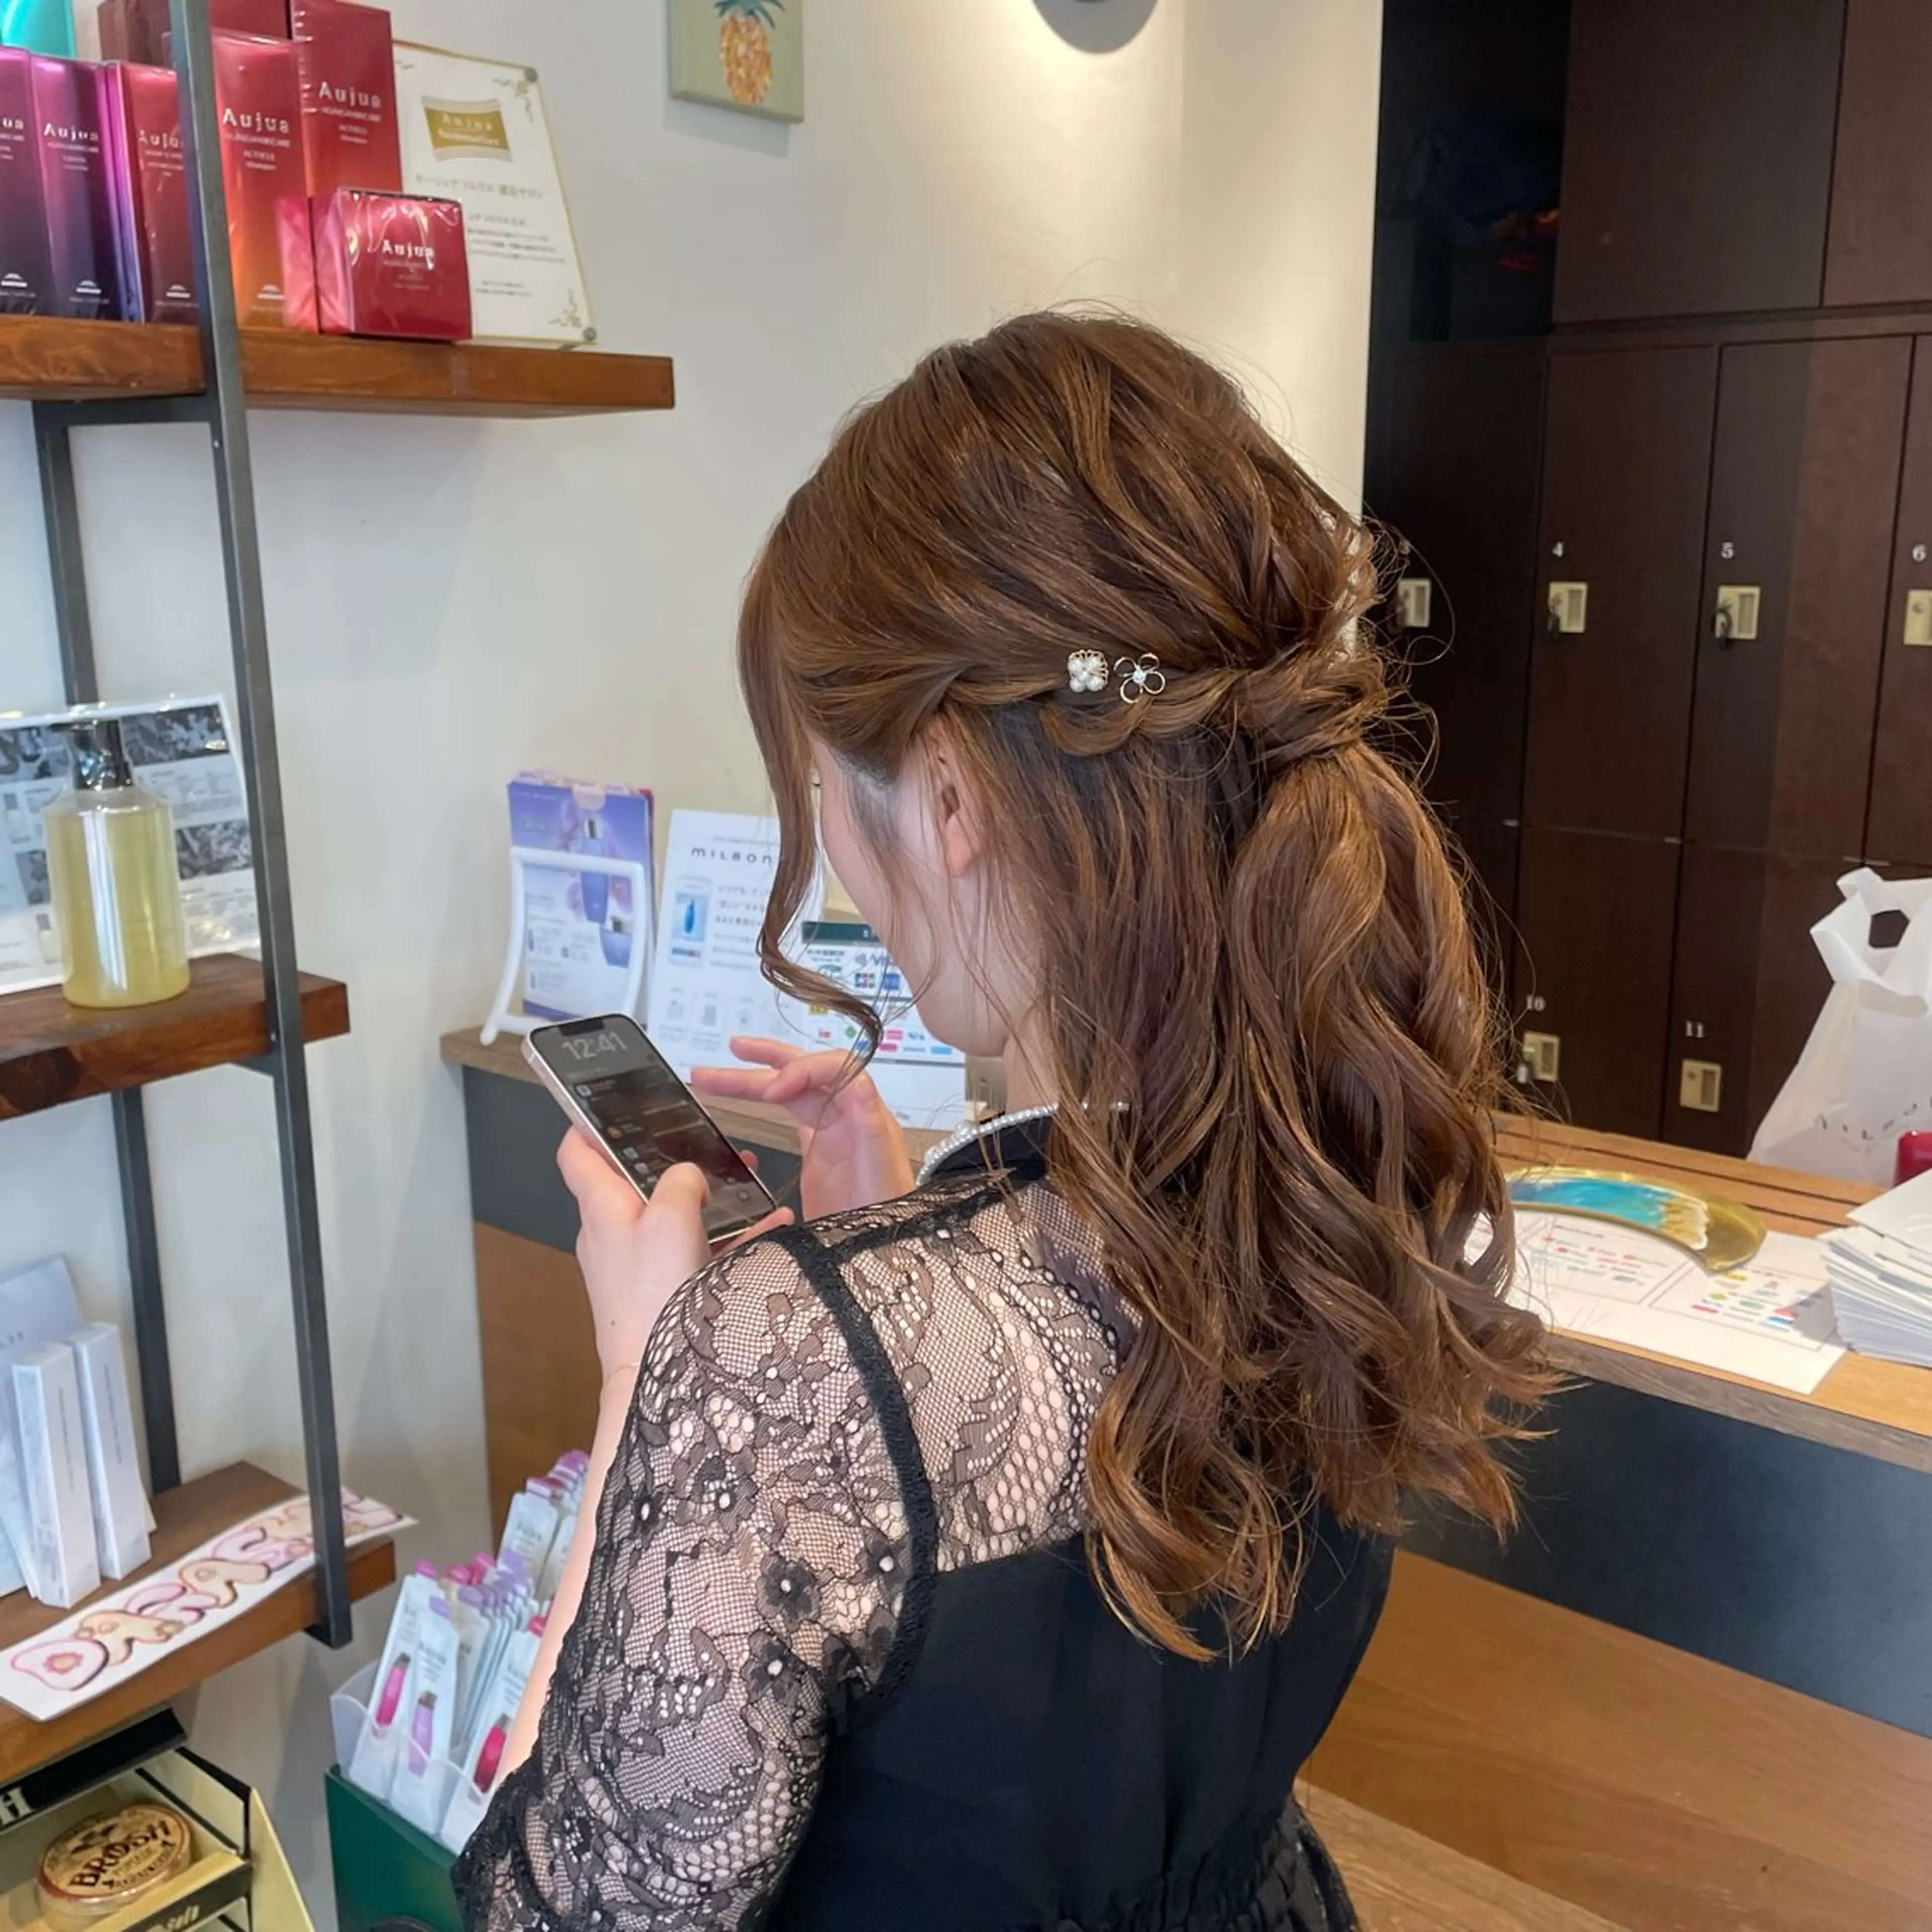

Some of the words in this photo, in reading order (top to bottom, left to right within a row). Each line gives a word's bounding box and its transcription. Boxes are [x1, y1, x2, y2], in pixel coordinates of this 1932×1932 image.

[318, 80, 381, 109] Aujua
[222, 108, 289, 134] Aujua
[44, 122, 99, 142] Aujua
[381, 238, 435, 259] Aujua
[1552, 541, 1563, 557] 4
[1721, 542, 1734, 559] 5
[1912, 544, 1927, 562] 6
[1525, 994, 1546, 1012] 10
[1685, 1020, 1705, 1039] 11
[561, 1031, 627, 1060] 12:41
[67, 1819, 171, 1887] BROSH
